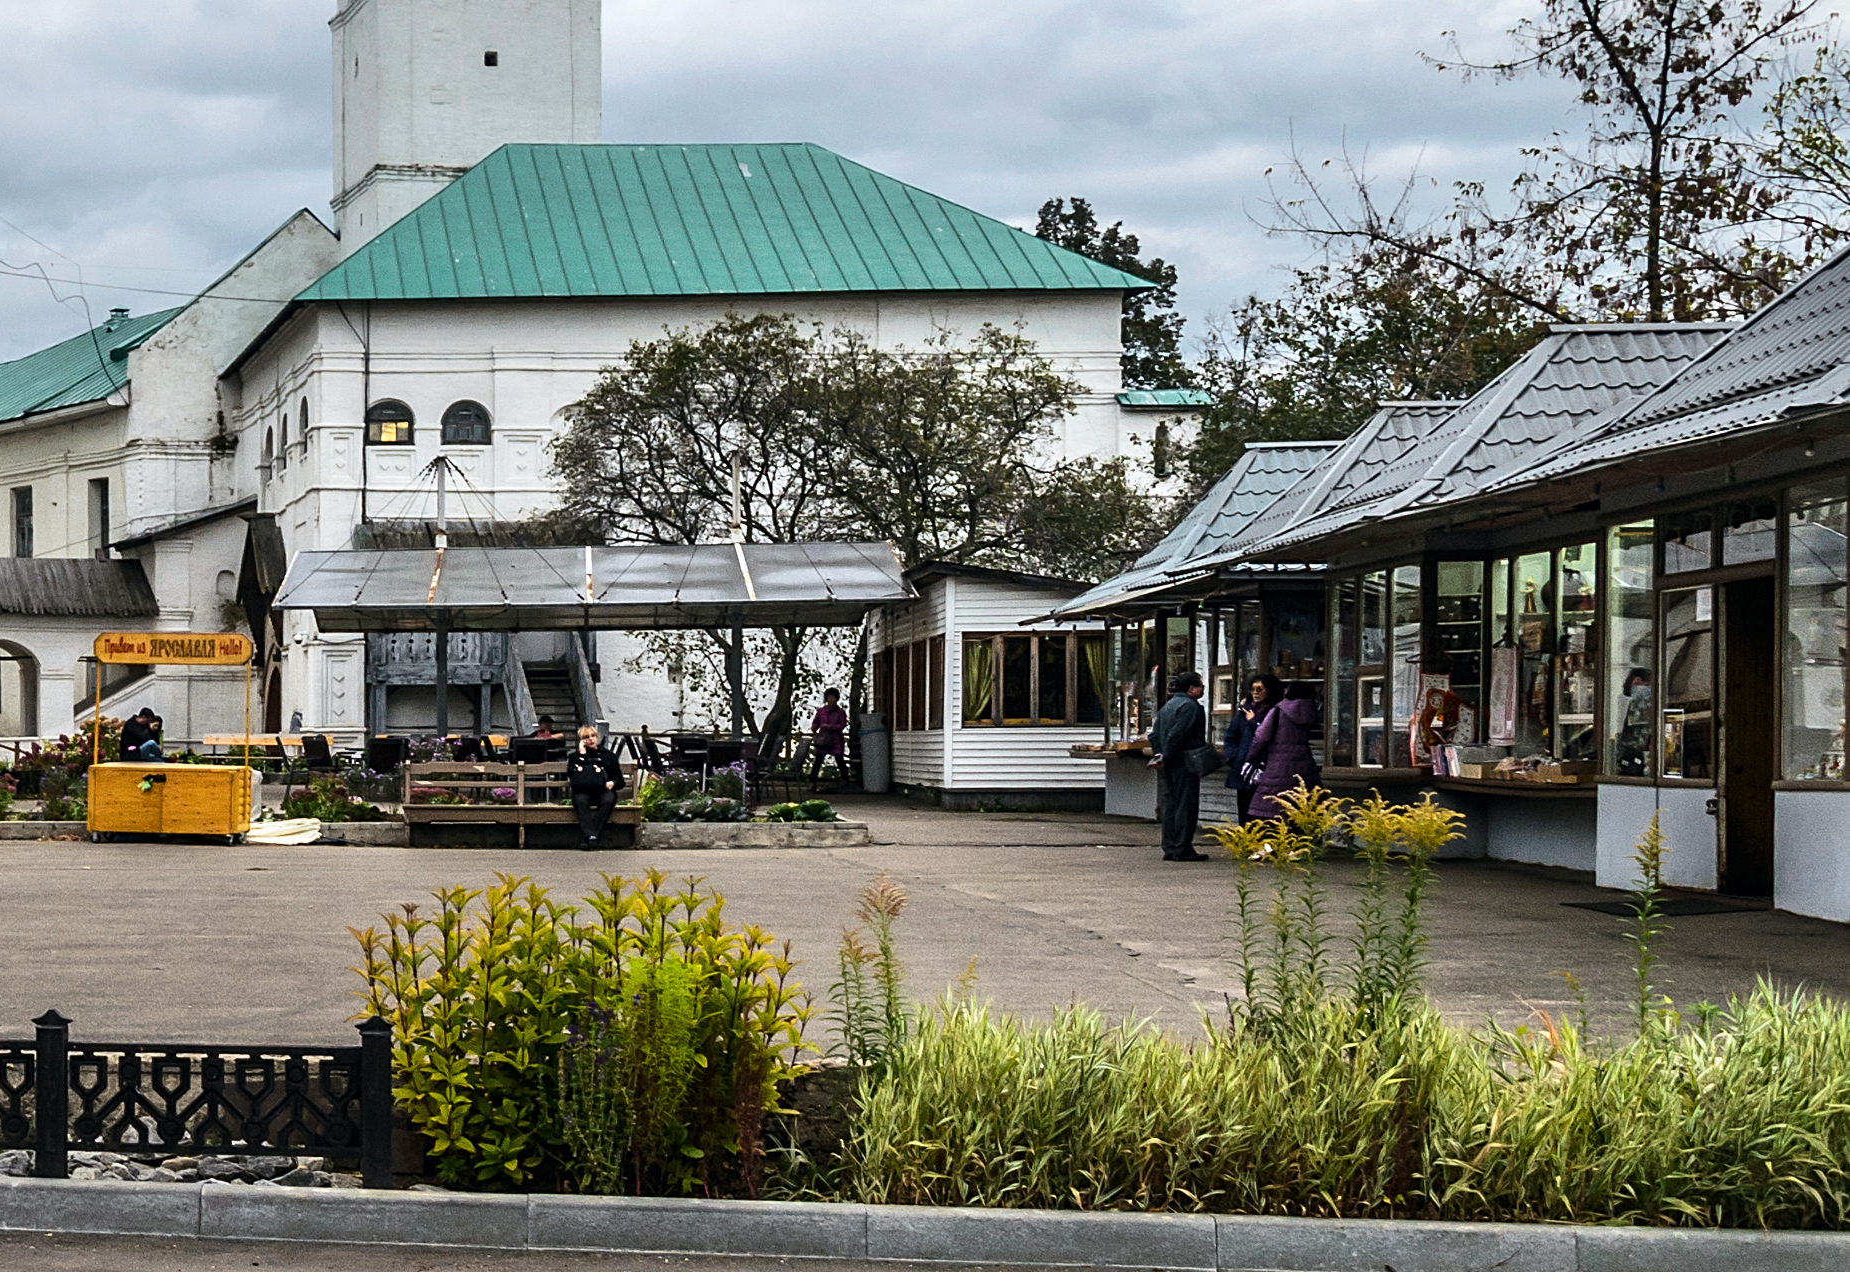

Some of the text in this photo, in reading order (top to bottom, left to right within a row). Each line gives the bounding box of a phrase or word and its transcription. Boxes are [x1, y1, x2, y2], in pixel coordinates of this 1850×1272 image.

[104, 636, 243, 659] Привет из ЯРОСЛАВЛЯ Hello!
